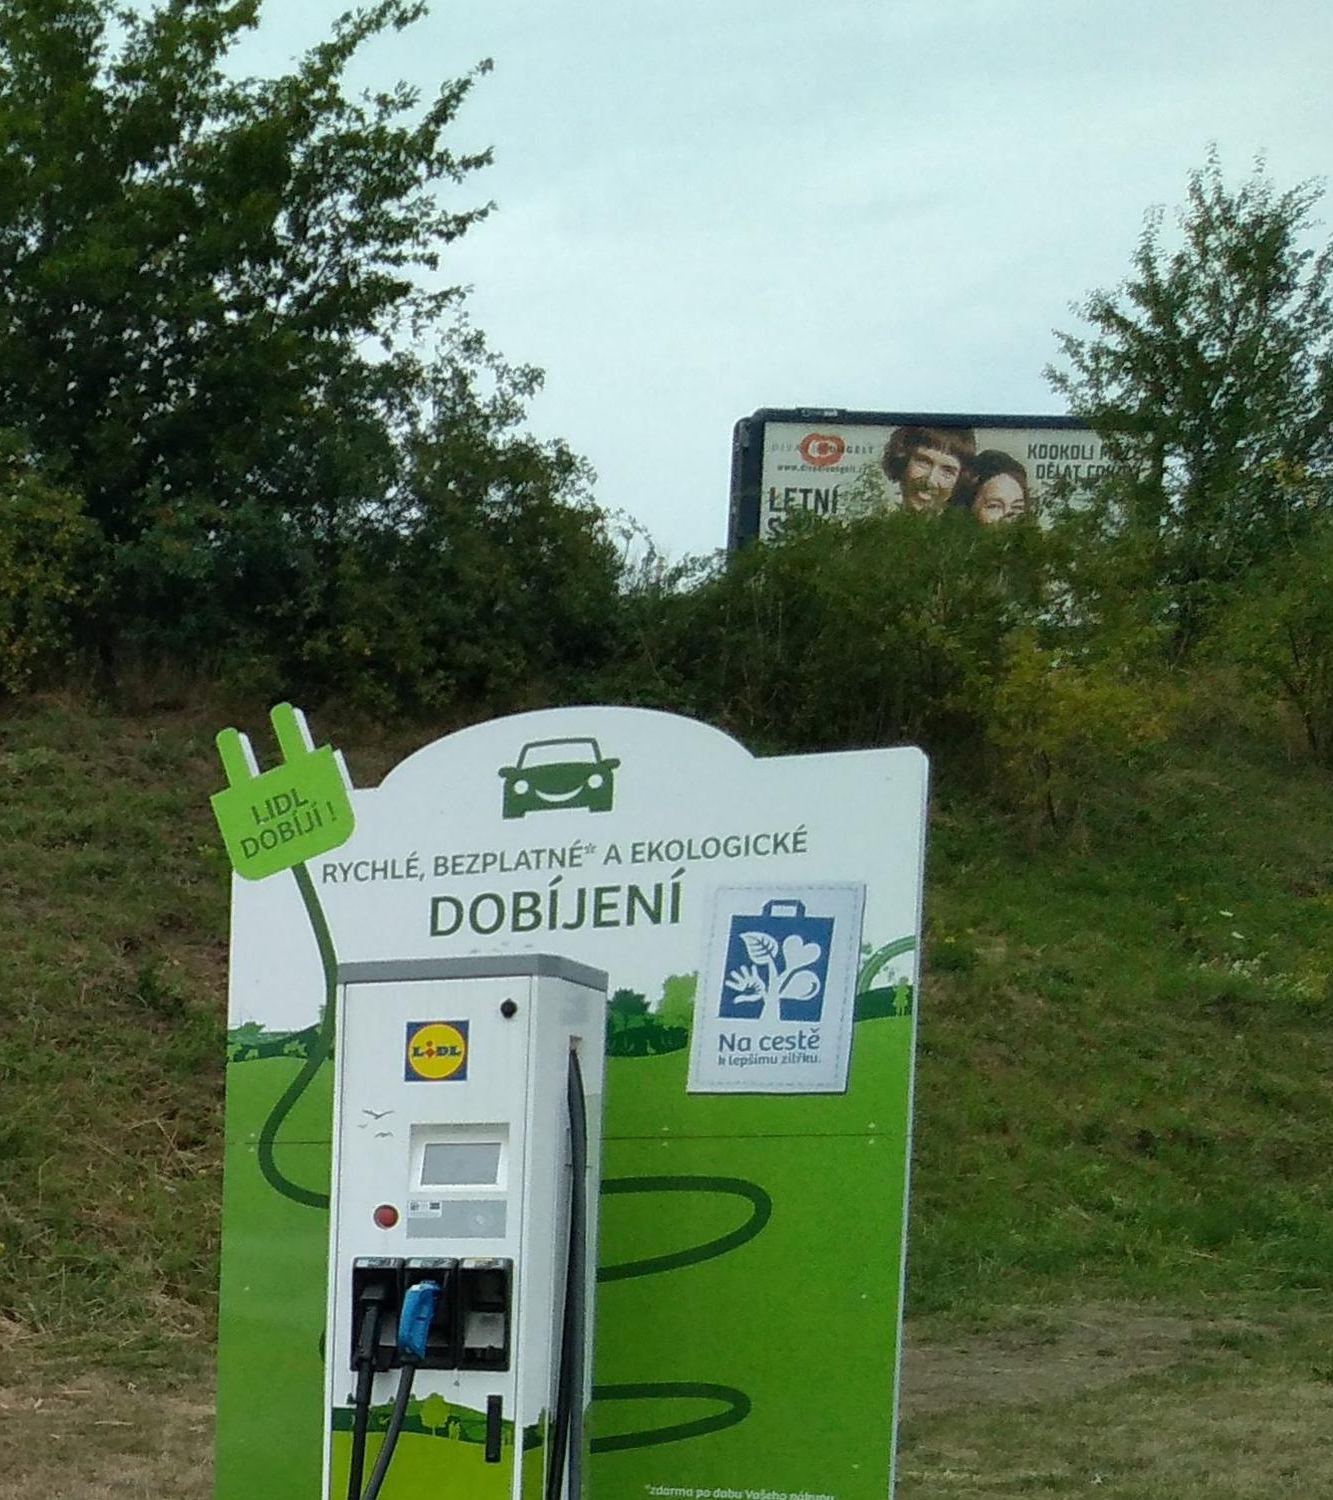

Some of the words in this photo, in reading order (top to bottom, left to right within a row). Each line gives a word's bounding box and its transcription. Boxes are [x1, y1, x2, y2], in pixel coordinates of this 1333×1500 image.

[768, 484, 840, 514] LETNÍ
[251, 787, 309, 824] LIDL
[322, 851, 426, 884] RYCHLÉ,
[603, 843, 623, 866] A
[630, 824, 808, 864] EKOLOGICKÉ
[429, 867, 686, 938] DOBÍJENÍ
[719, 1032, 752, 1053] Na
[758, 1027, 821, 1052] cestě
